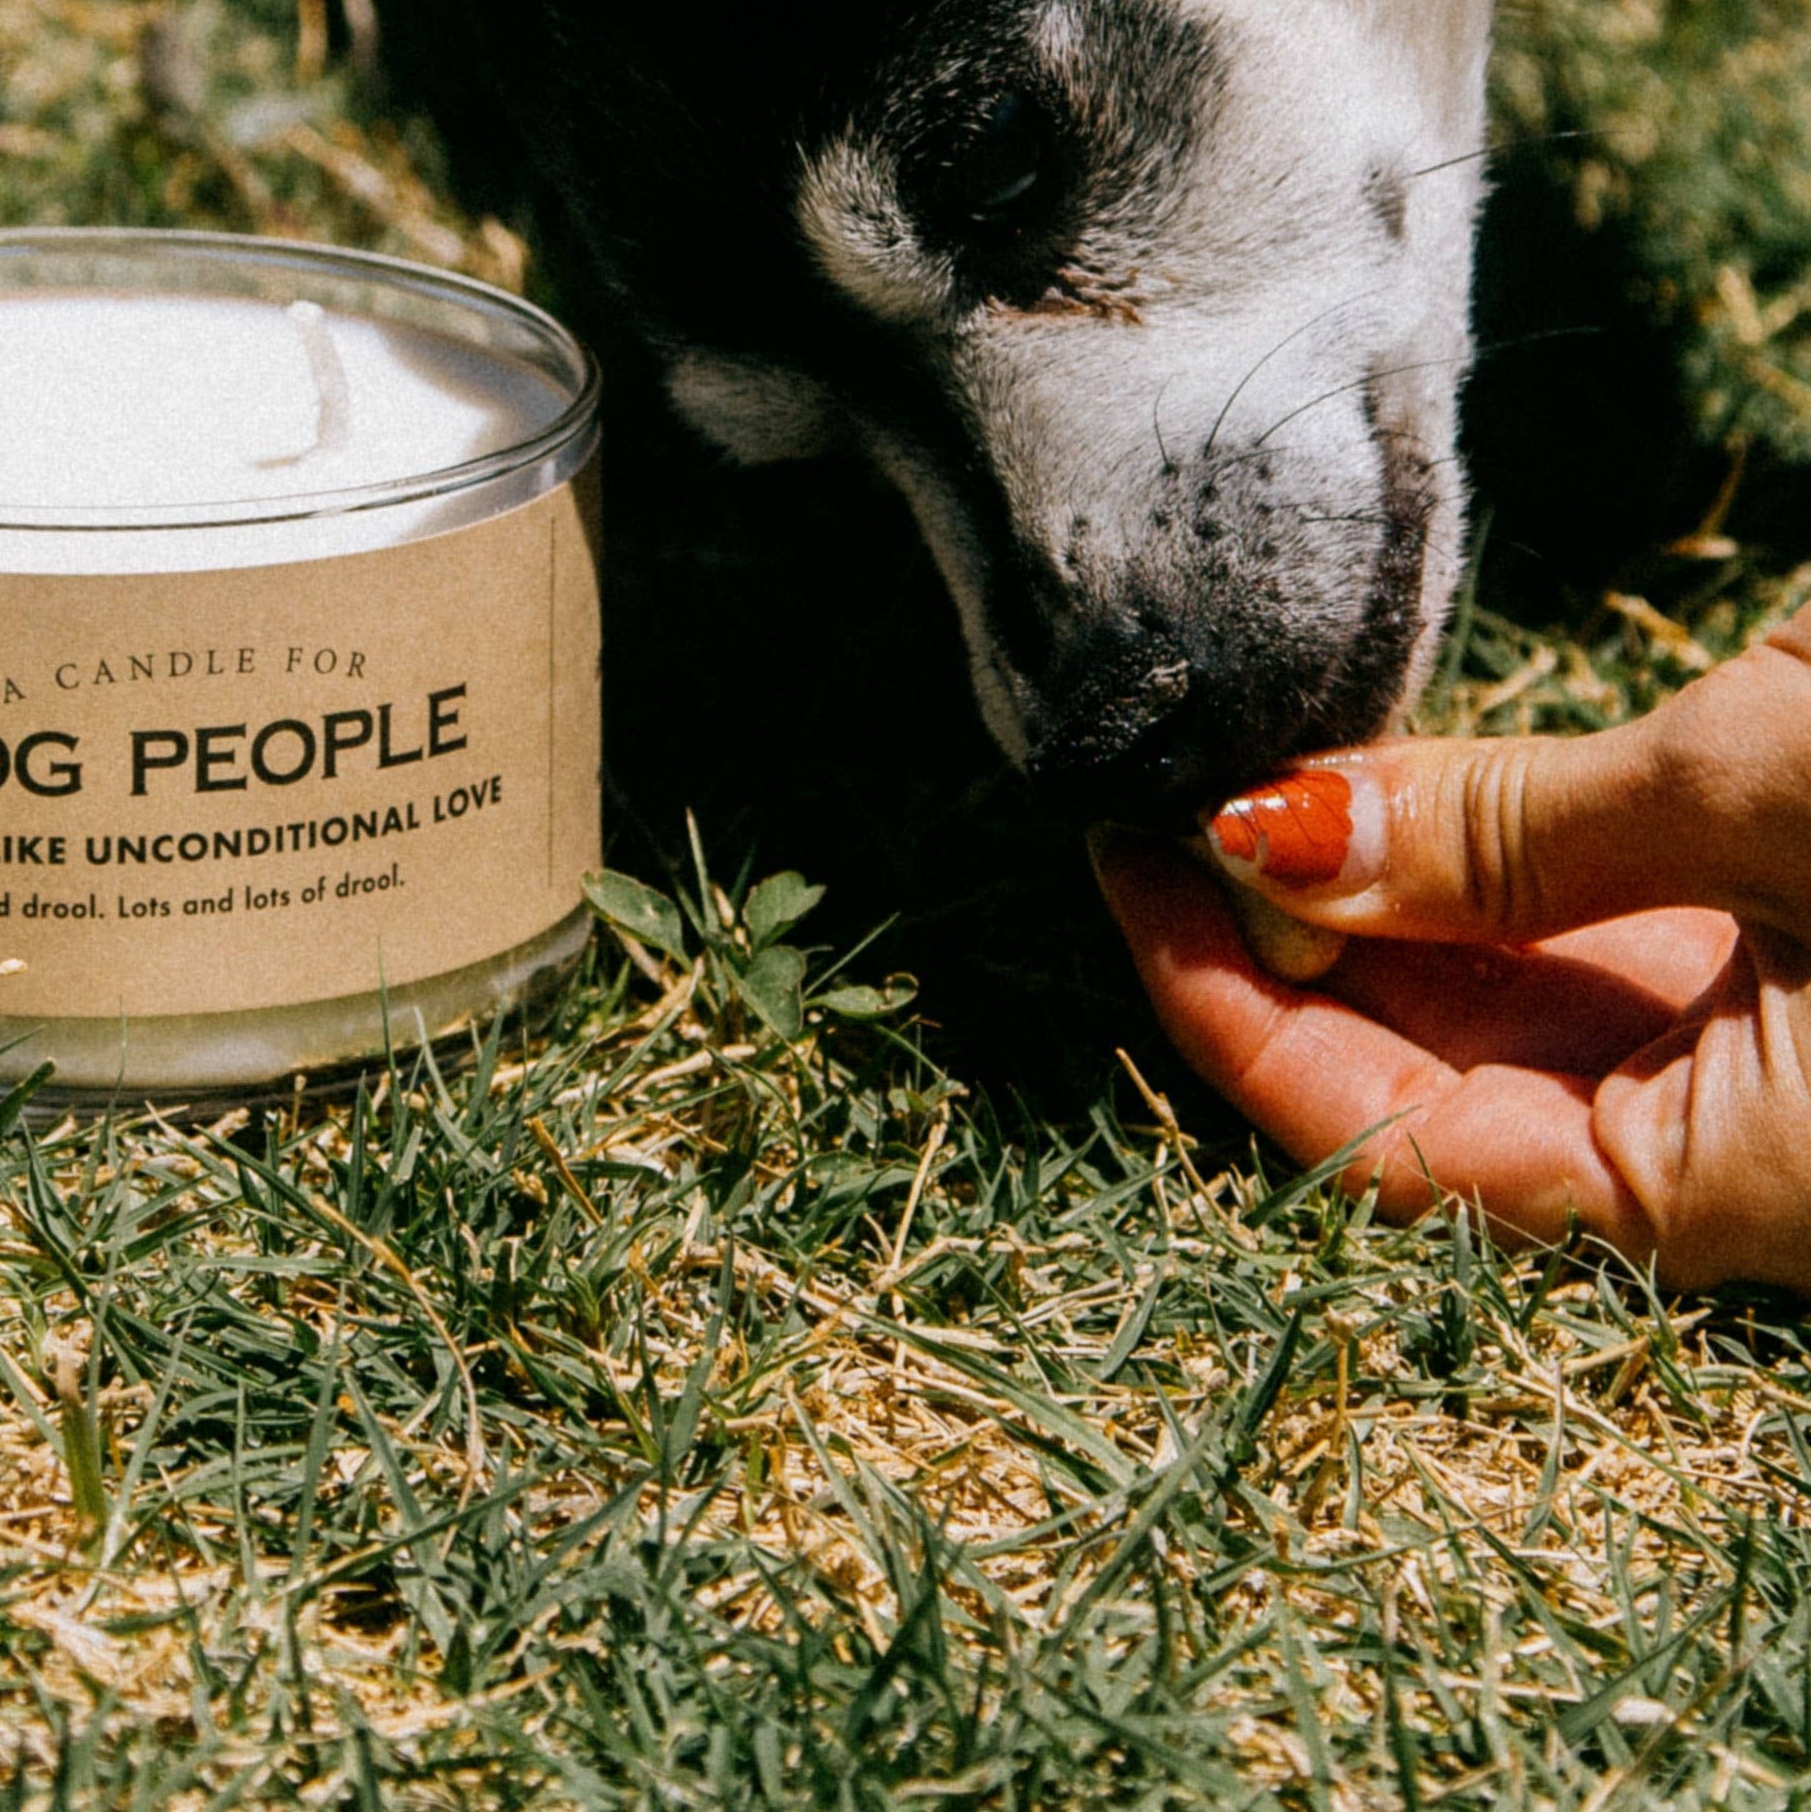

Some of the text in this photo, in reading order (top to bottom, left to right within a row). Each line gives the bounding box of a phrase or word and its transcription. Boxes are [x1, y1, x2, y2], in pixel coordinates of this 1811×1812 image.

[1, 646, 368, 705] A CANDLE FOR
[129, 682, 468, 797] PEOPLE
[85, 801, 421, 866] UNCONDITIONAL
[433, 774, 502, 824] LOVE
[21, 893, 105, 920] drool.
[118, 895, 171, 919] Lots
[182, 887, 234, 916] and
[245, 885, 291, 910] lots
[300, 875, 326, 904] of
[334, 862, 405, 899] drool.
